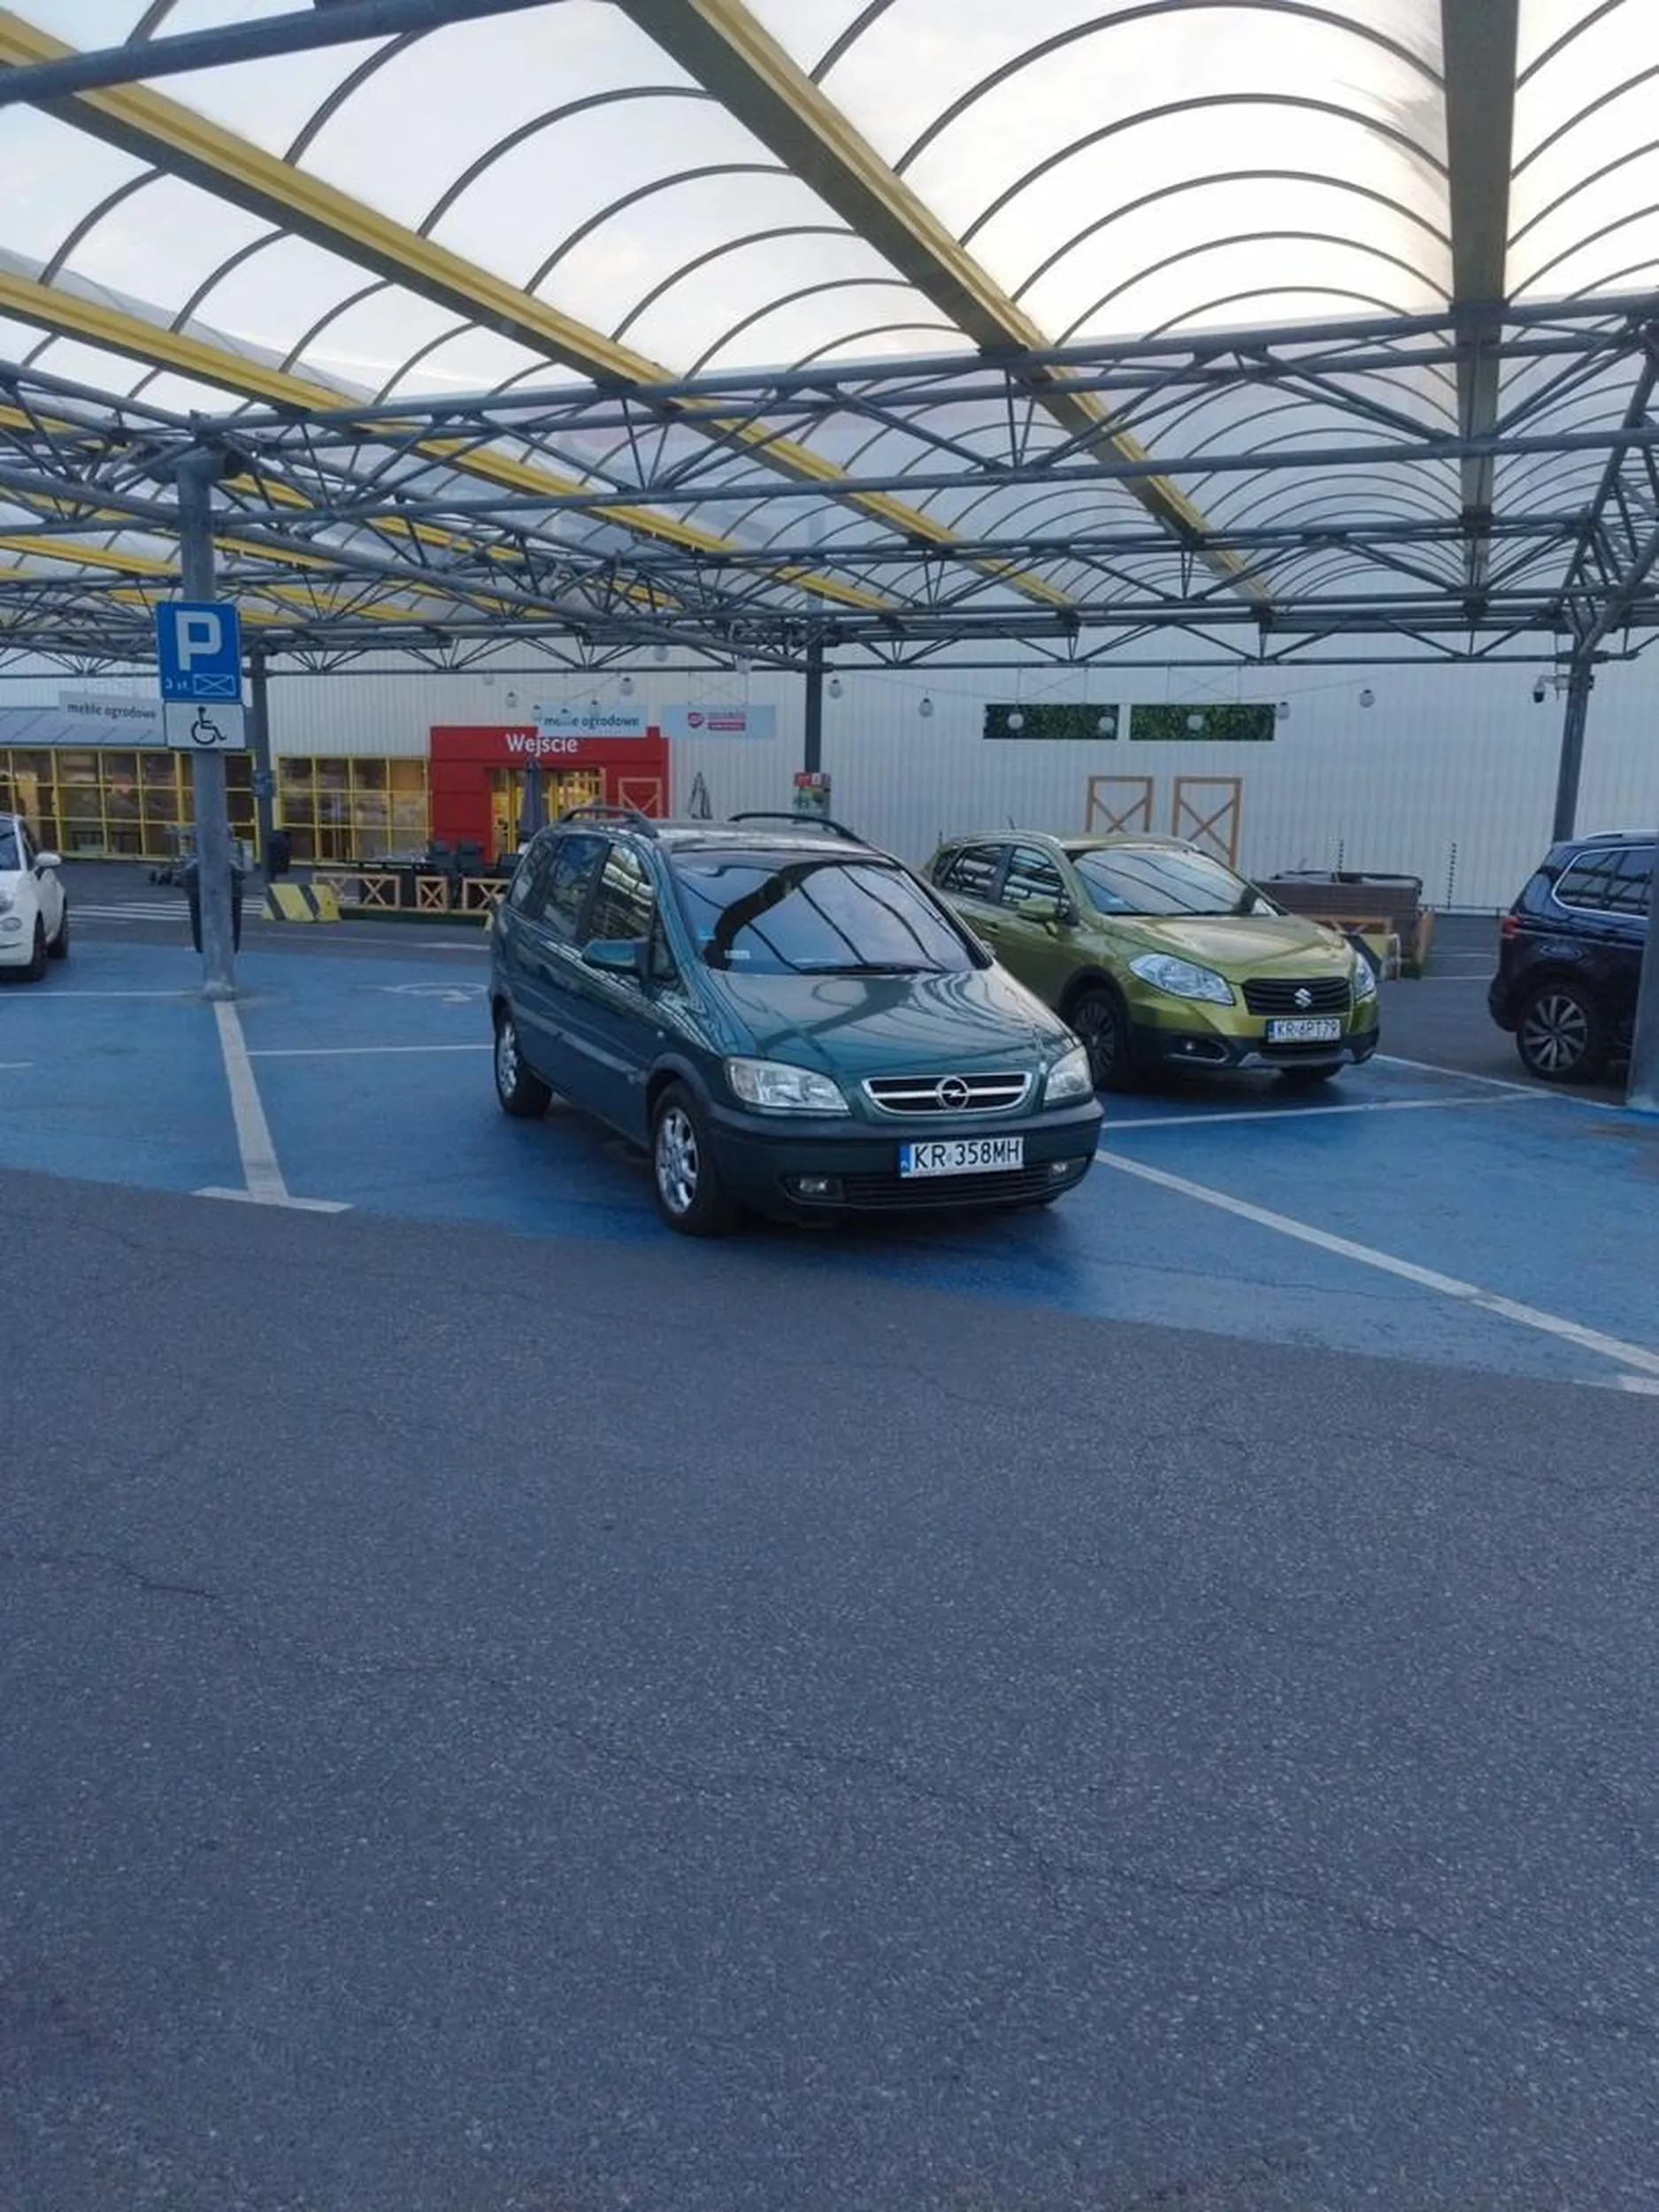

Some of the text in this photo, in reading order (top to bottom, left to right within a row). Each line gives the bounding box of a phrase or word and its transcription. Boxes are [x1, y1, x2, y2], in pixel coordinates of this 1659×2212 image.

[175, 611, 222, 671] P
[581, 713, 640, 729] ogrodowe
[914, 1144, 946, 1169] KR
[955, 1140, 1019, 1166] 358MH
